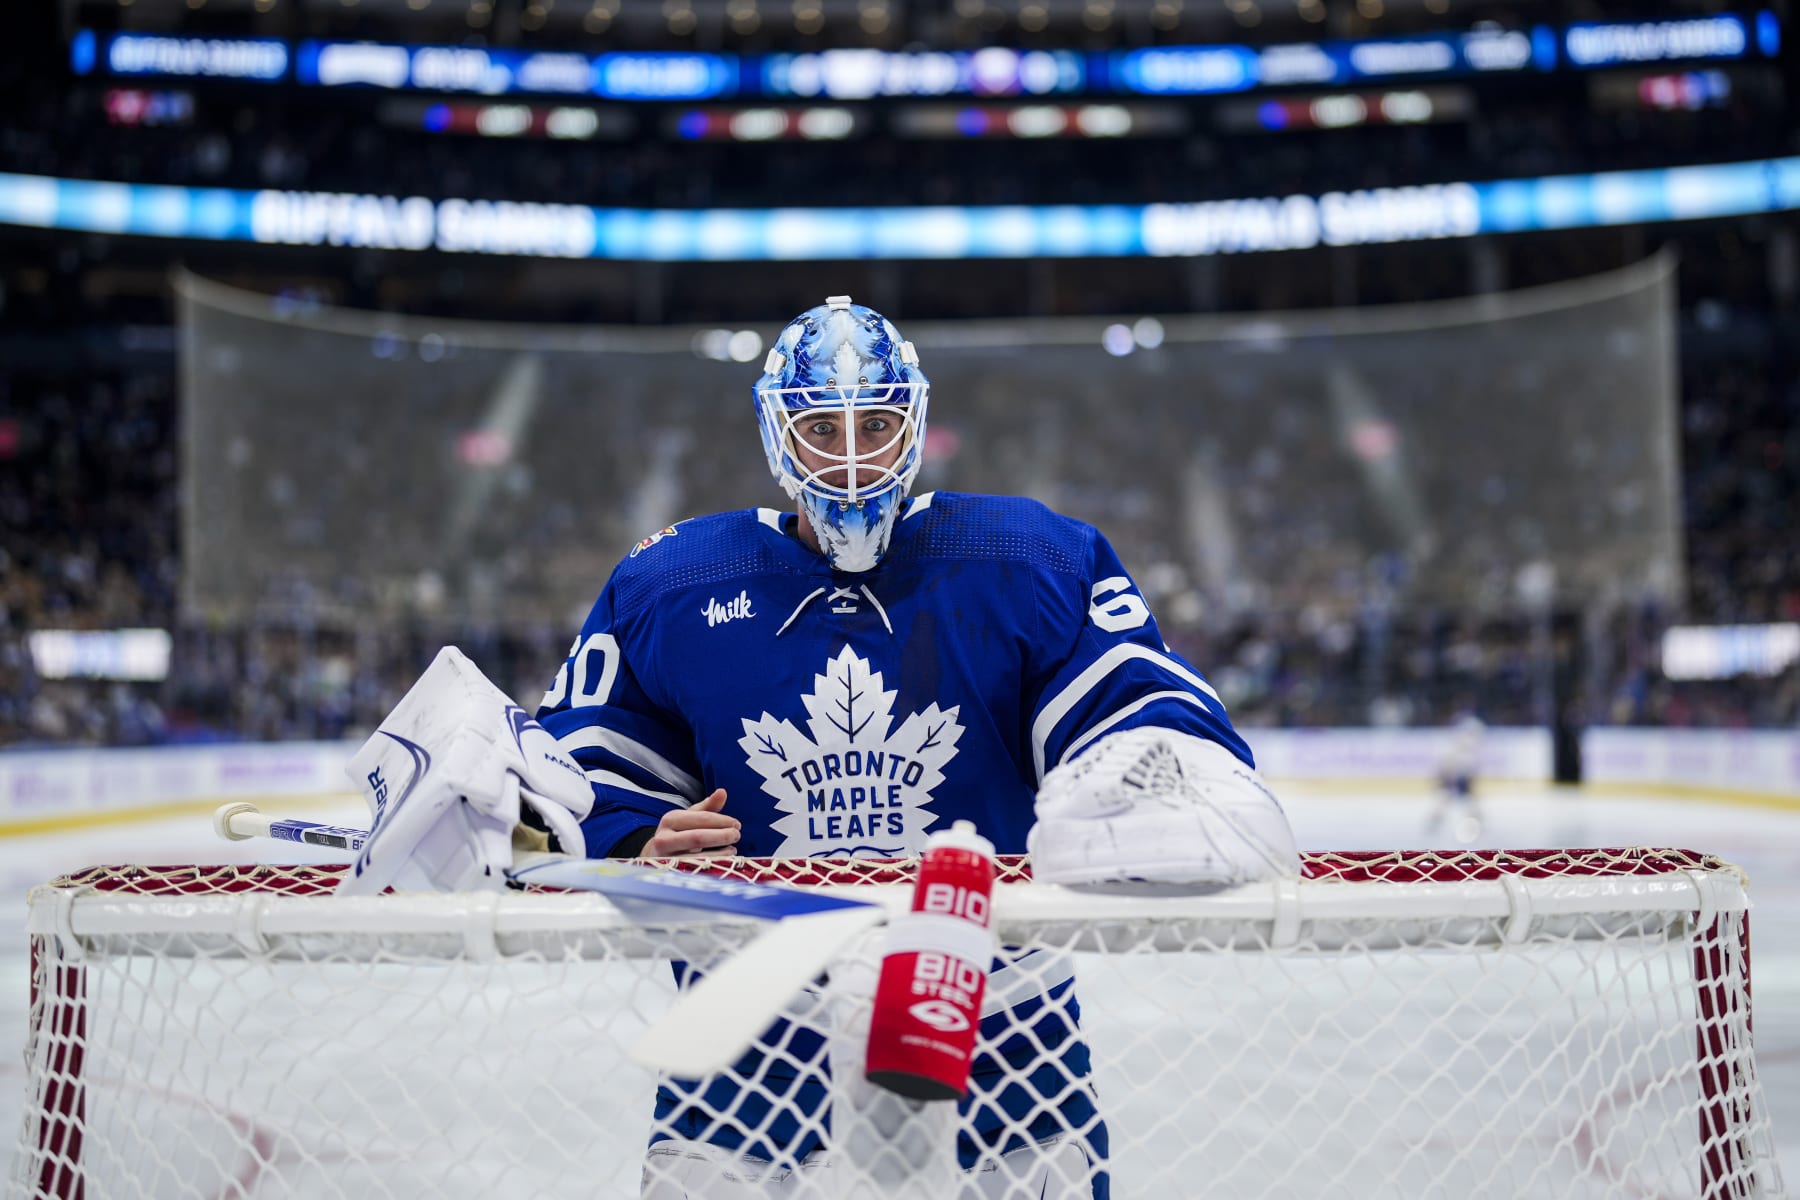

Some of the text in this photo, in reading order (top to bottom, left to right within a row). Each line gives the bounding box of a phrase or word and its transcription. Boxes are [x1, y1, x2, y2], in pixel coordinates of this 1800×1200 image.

[700, 590, 757, 627] Milk
[781, 750, 924, 793] TORONTO
[807, 784, 903, 812] MAPLE
[808, 812, 904, 840] LEAFS
[924, 882, 988, 926] BIO
[914, 951, 980, 995] BIO
[910, 979, 975, 1011] STEEL
